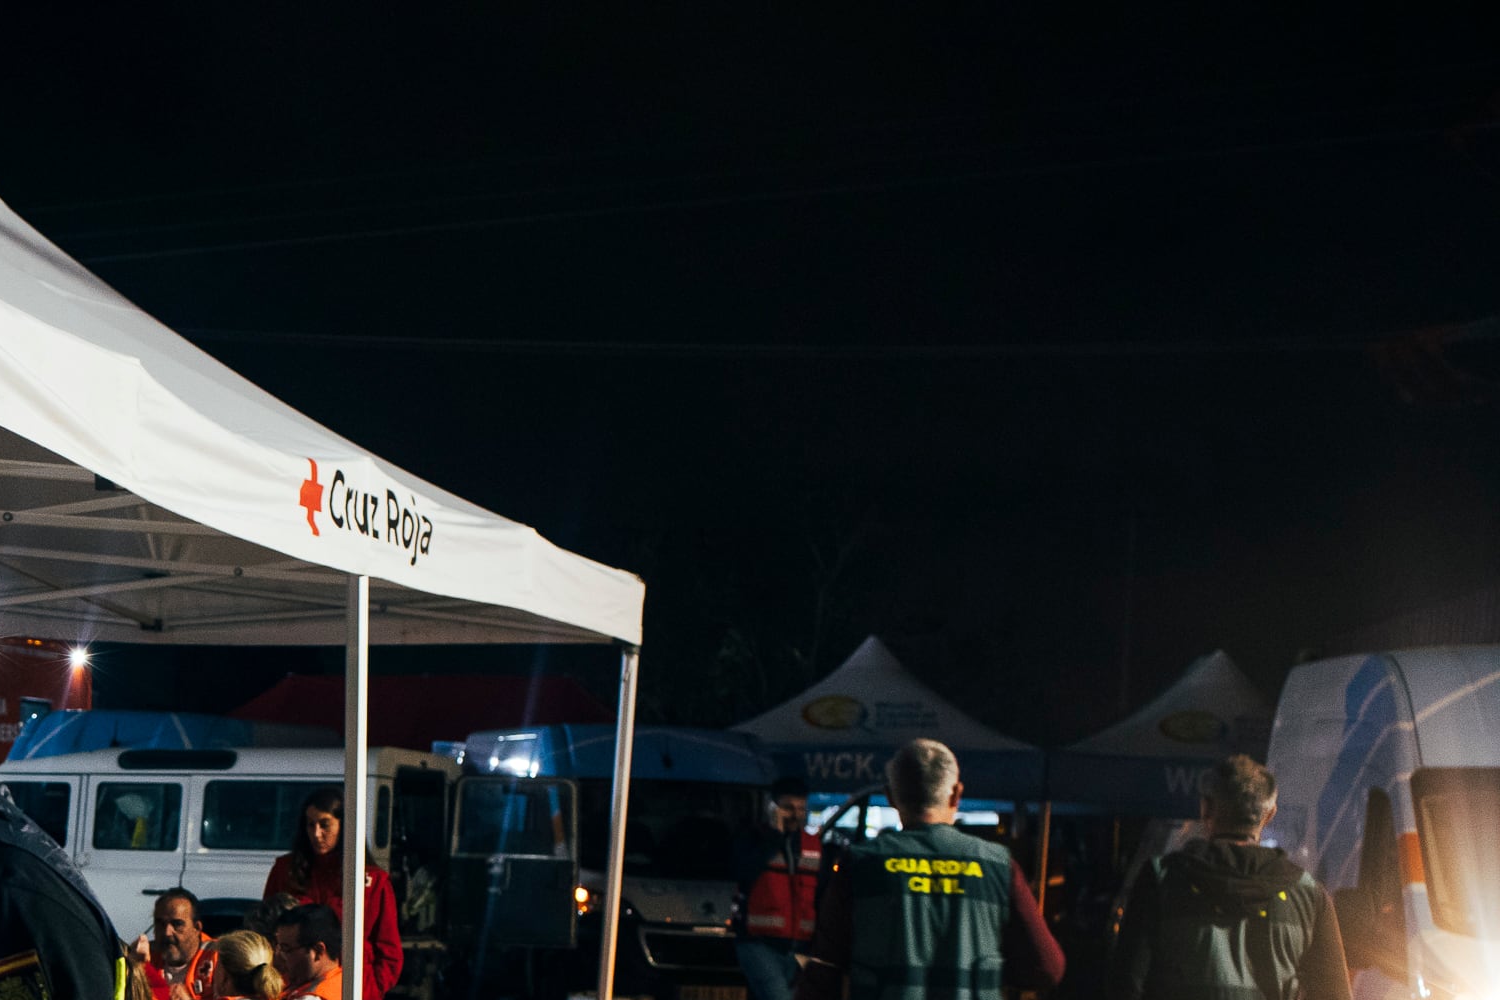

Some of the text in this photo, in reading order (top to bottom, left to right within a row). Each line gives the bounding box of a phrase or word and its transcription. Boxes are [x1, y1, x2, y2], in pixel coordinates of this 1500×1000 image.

[329, 470, 433, 566] Cruz Roja
[884, 857, 983, 878] GUARDIA
